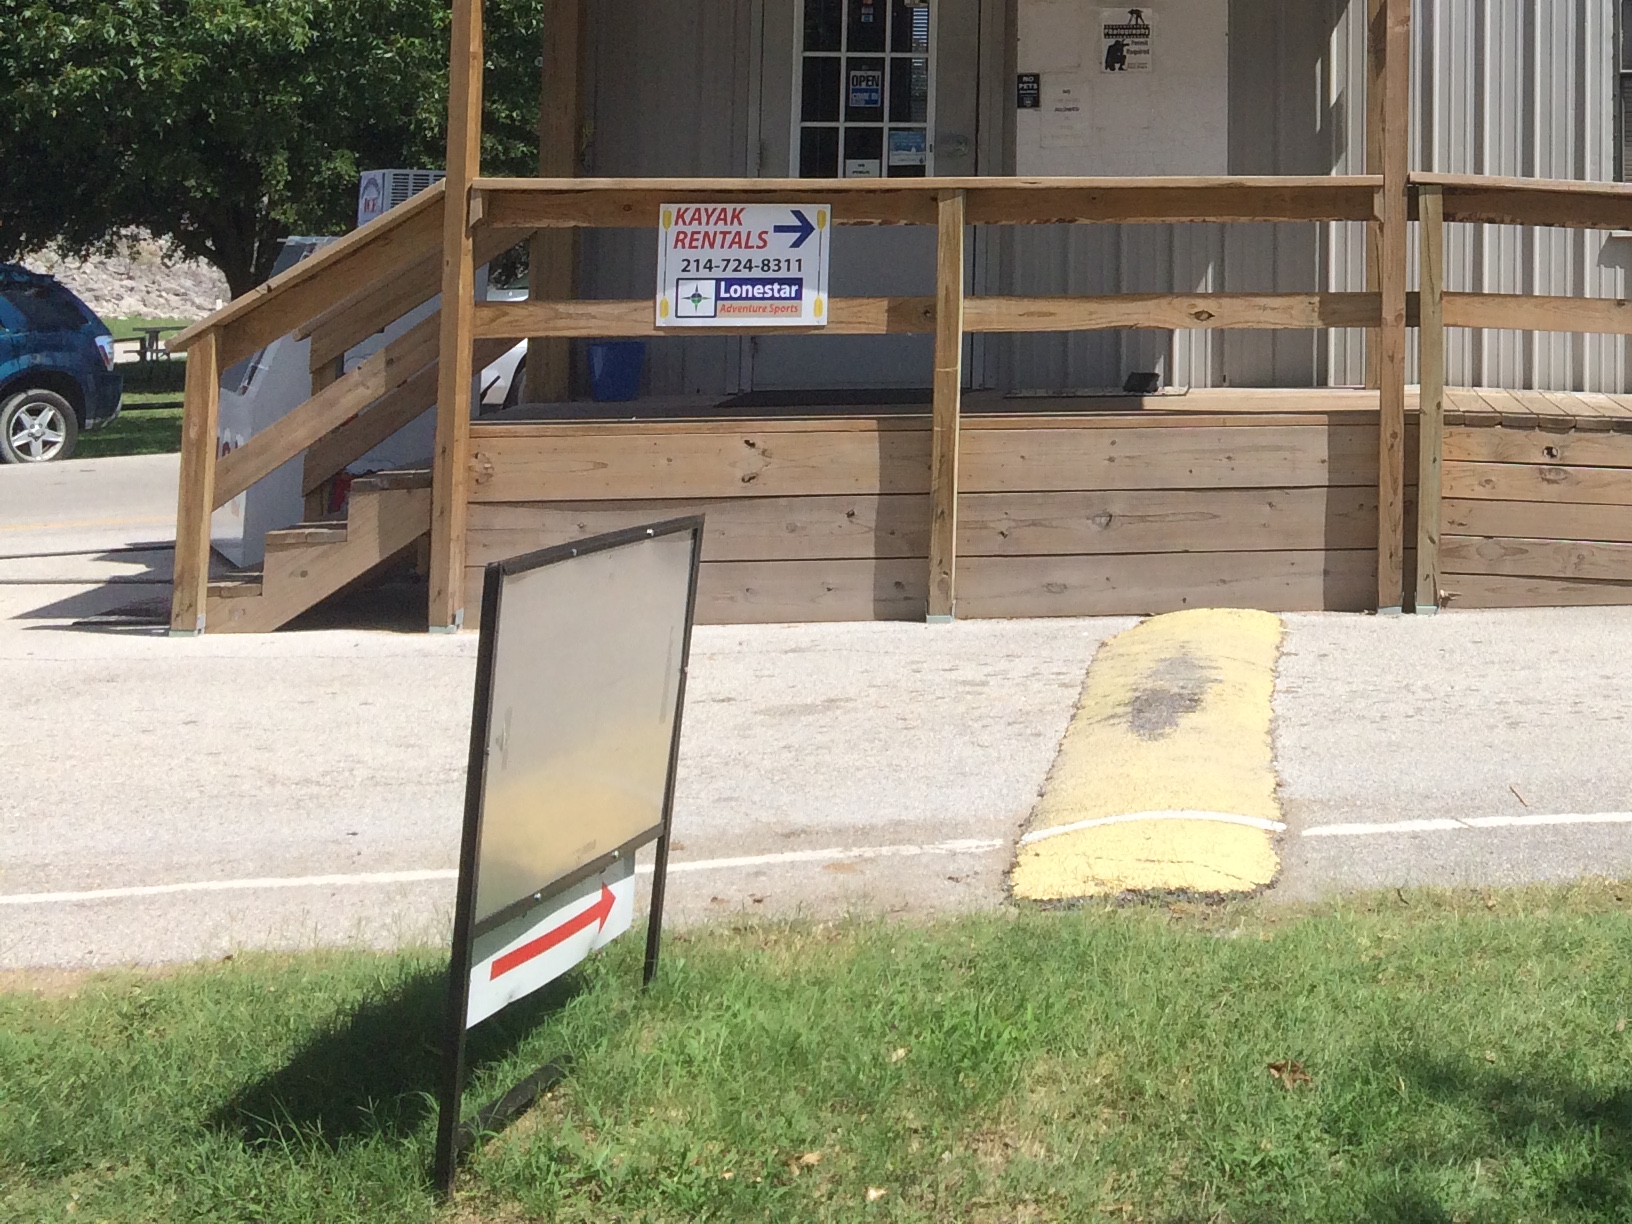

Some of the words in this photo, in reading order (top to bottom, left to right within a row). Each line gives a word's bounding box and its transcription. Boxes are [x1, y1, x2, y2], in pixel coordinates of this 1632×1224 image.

[852, 74, 880, 87] OPEN
[674, 207, 746, 226] KAYAK
[673, 230, 769, 250] RENTALS
[680, 258, 803, 273] 214-724-8311
[719, 281, 799, 299] Lonestar
[719, 303, 767, 314] Adventure
[769, 303, 799, 315] Sports
